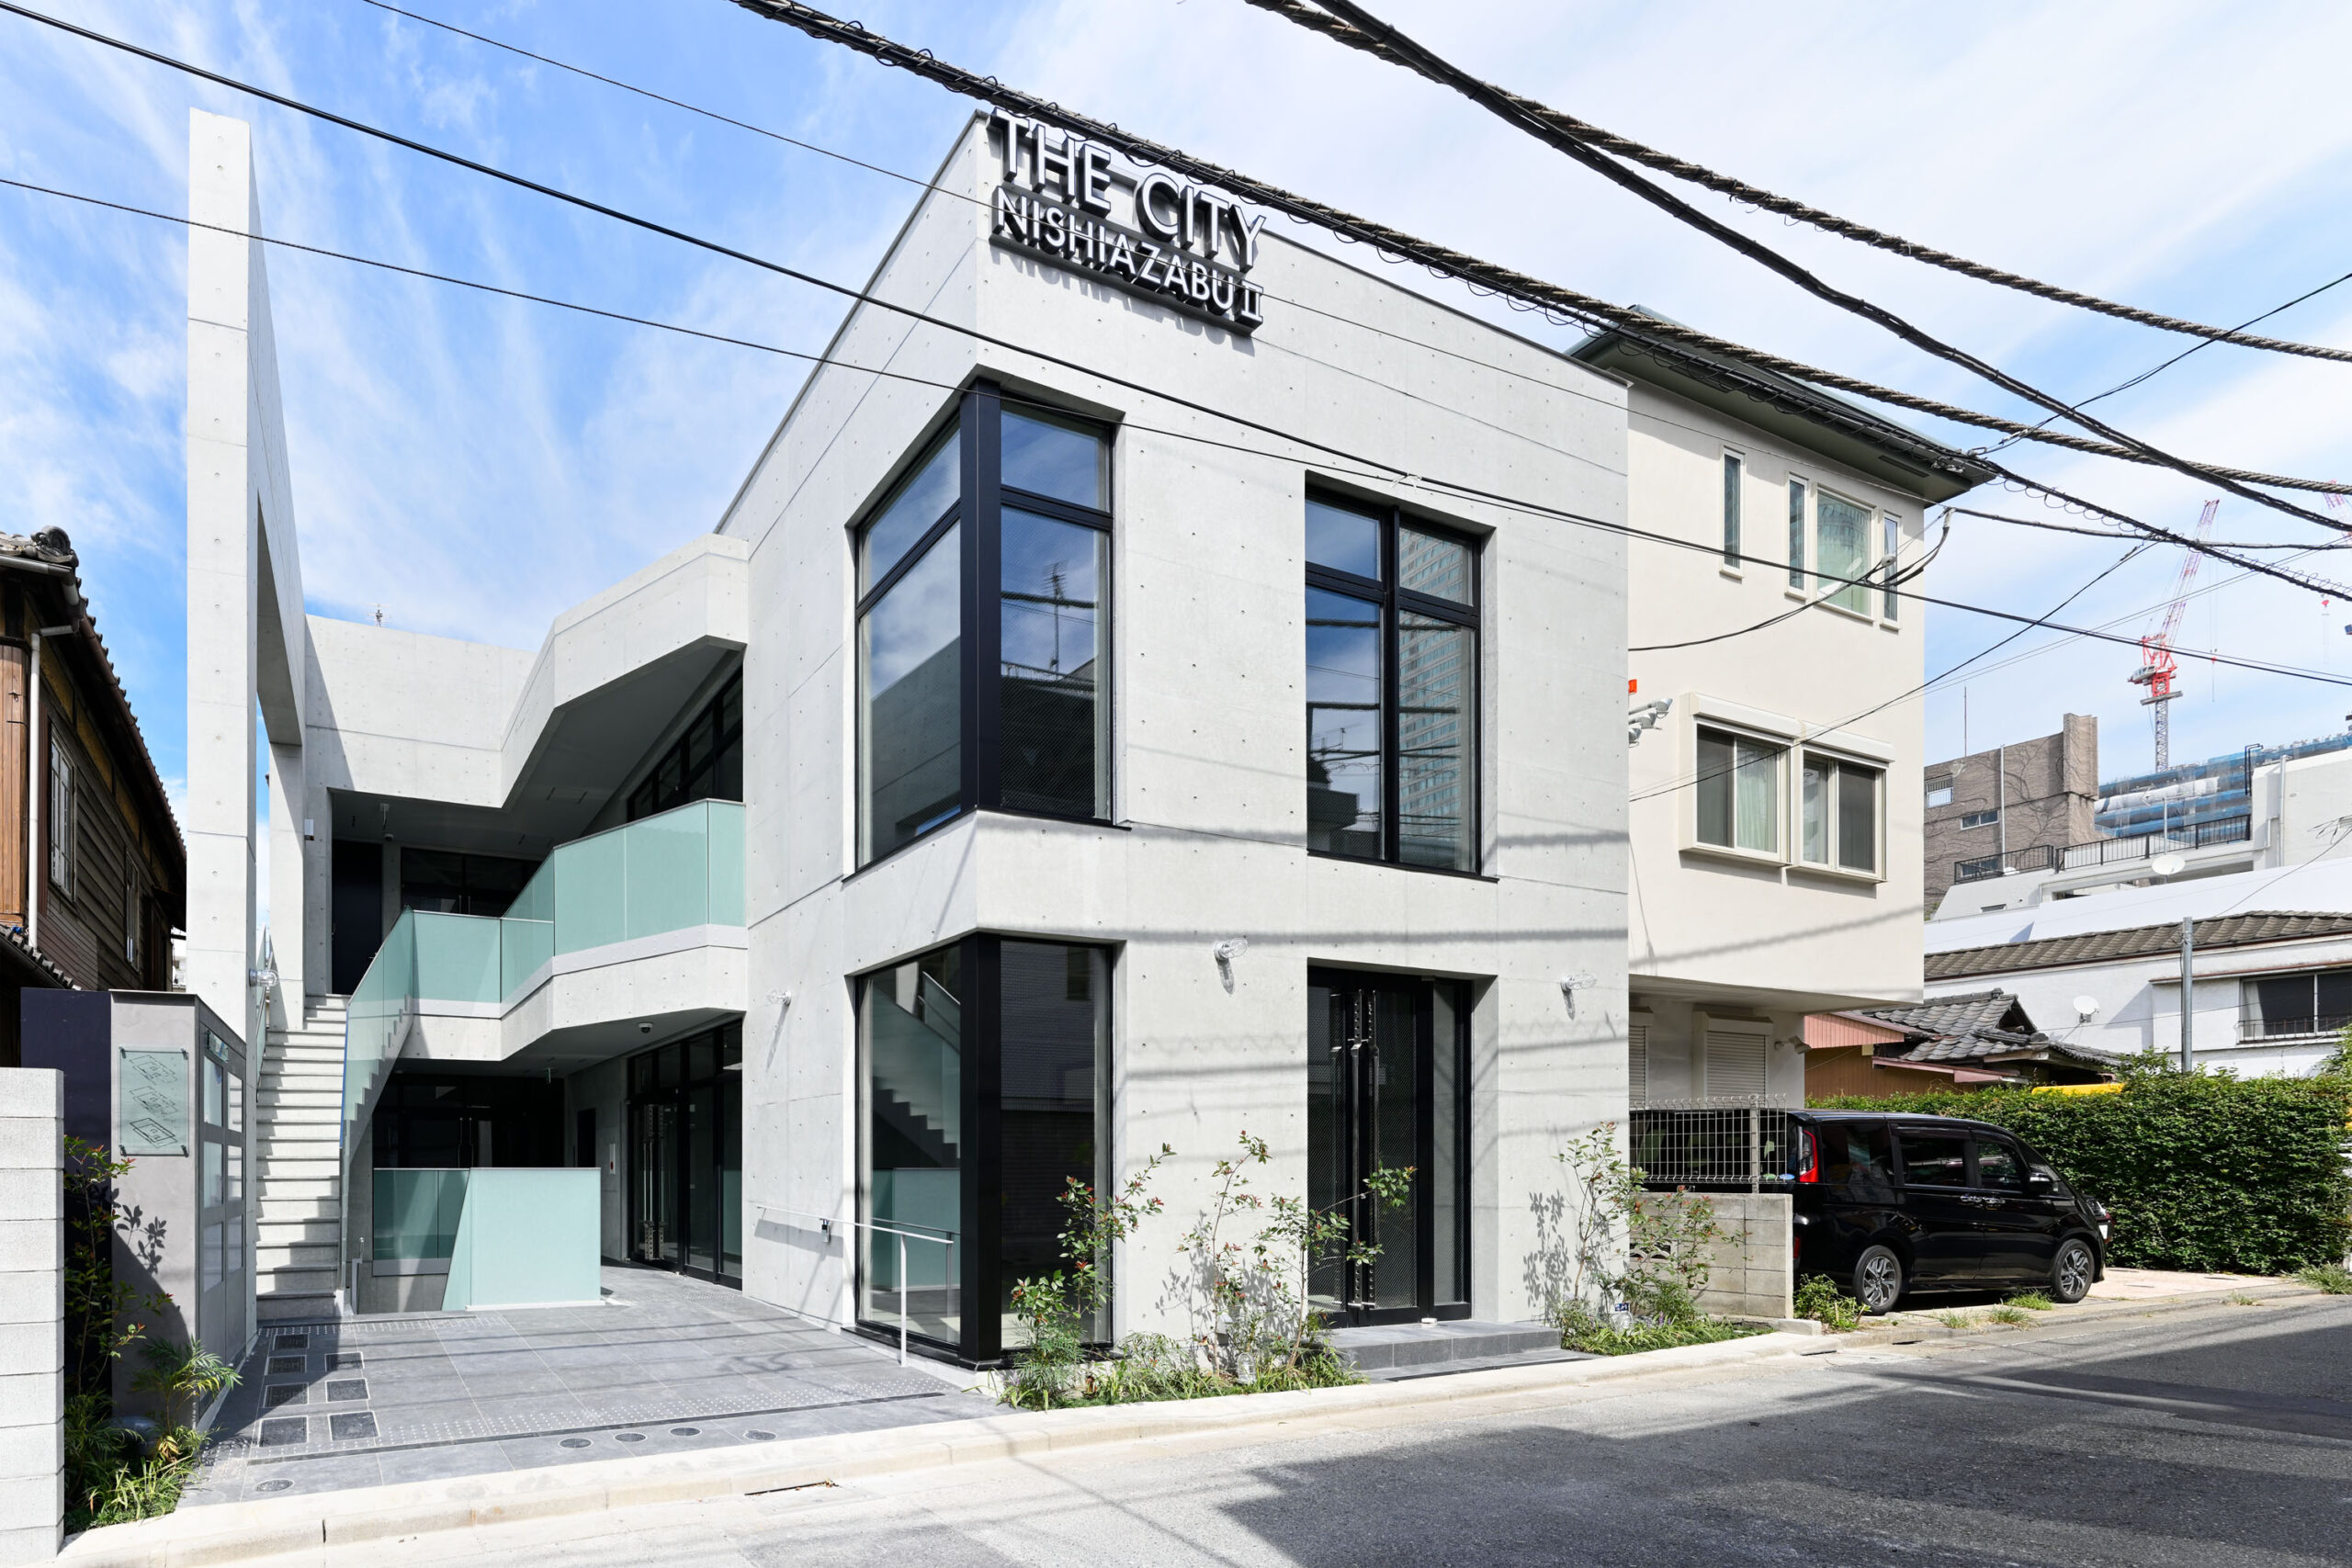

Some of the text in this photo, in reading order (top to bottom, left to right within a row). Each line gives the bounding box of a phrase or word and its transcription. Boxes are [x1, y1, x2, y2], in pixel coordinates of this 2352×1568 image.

[995, 107, 1266, 268] THE CITY
[997, 186, 1233, 309] NISHIAZABU
